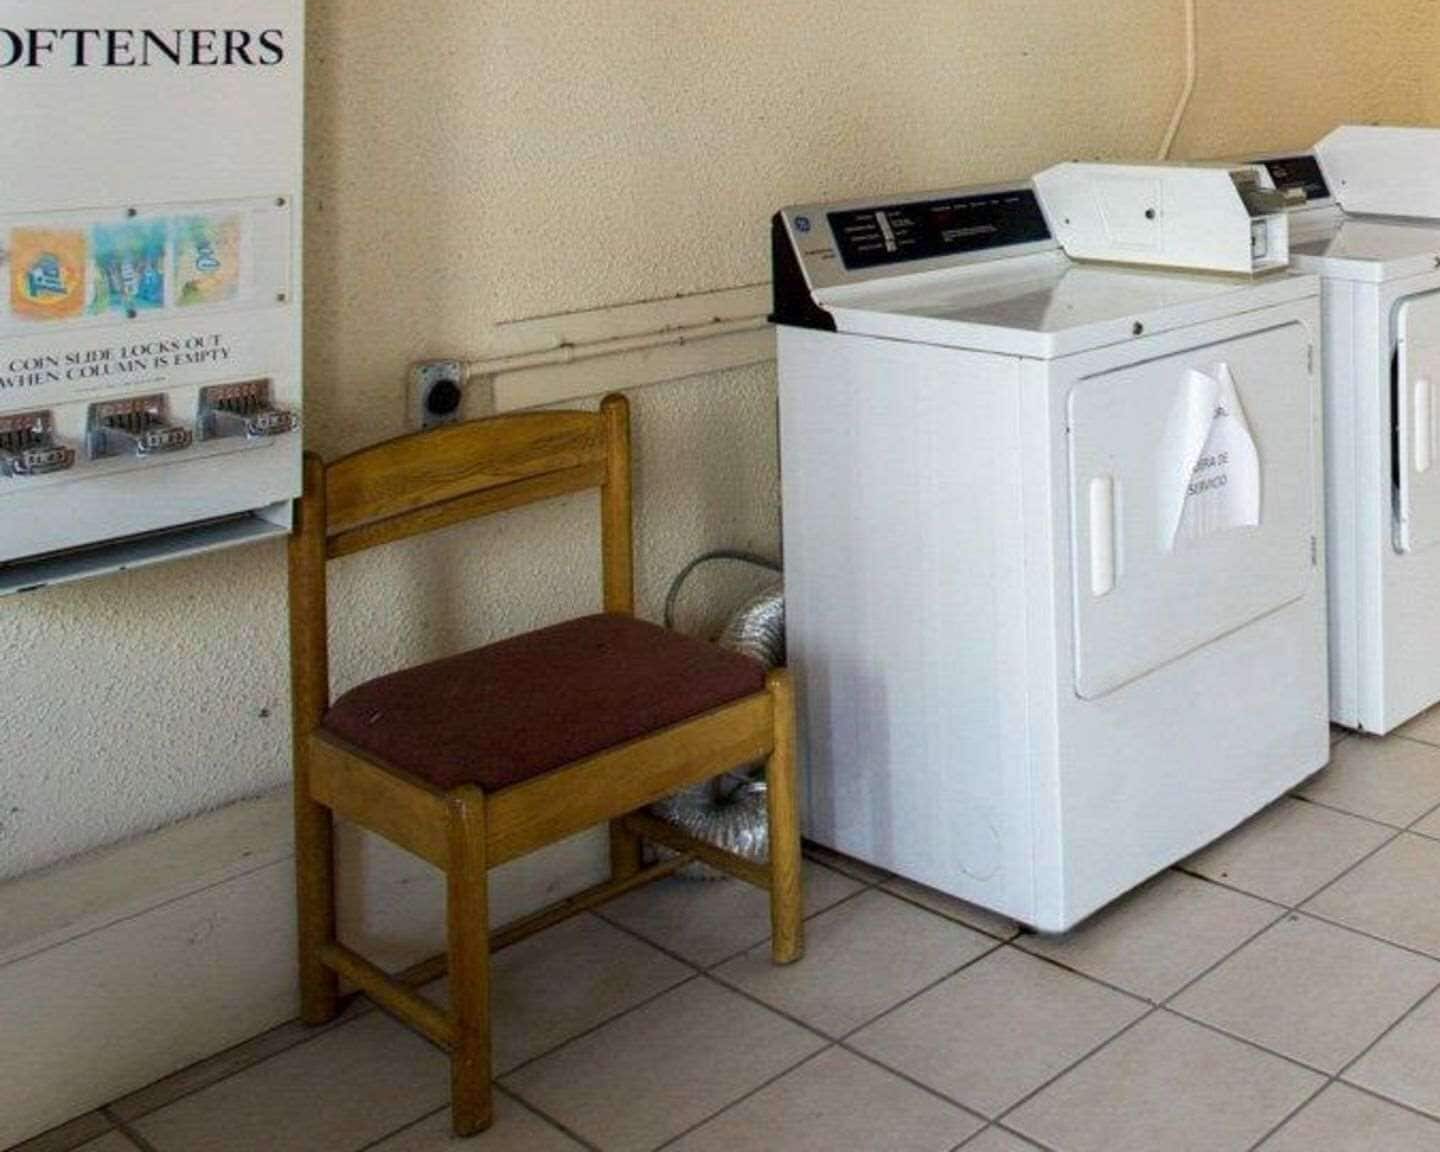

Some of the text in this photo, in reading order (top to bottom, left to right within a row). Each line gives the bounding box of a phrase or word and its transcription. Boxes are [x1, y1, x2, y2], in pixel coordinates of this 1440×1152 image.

[0, 346, 231, 389] WHEN COLUMN IS EMPTY
[8, 334, 222, 373] COIN SLIDE LOCKS OUT
